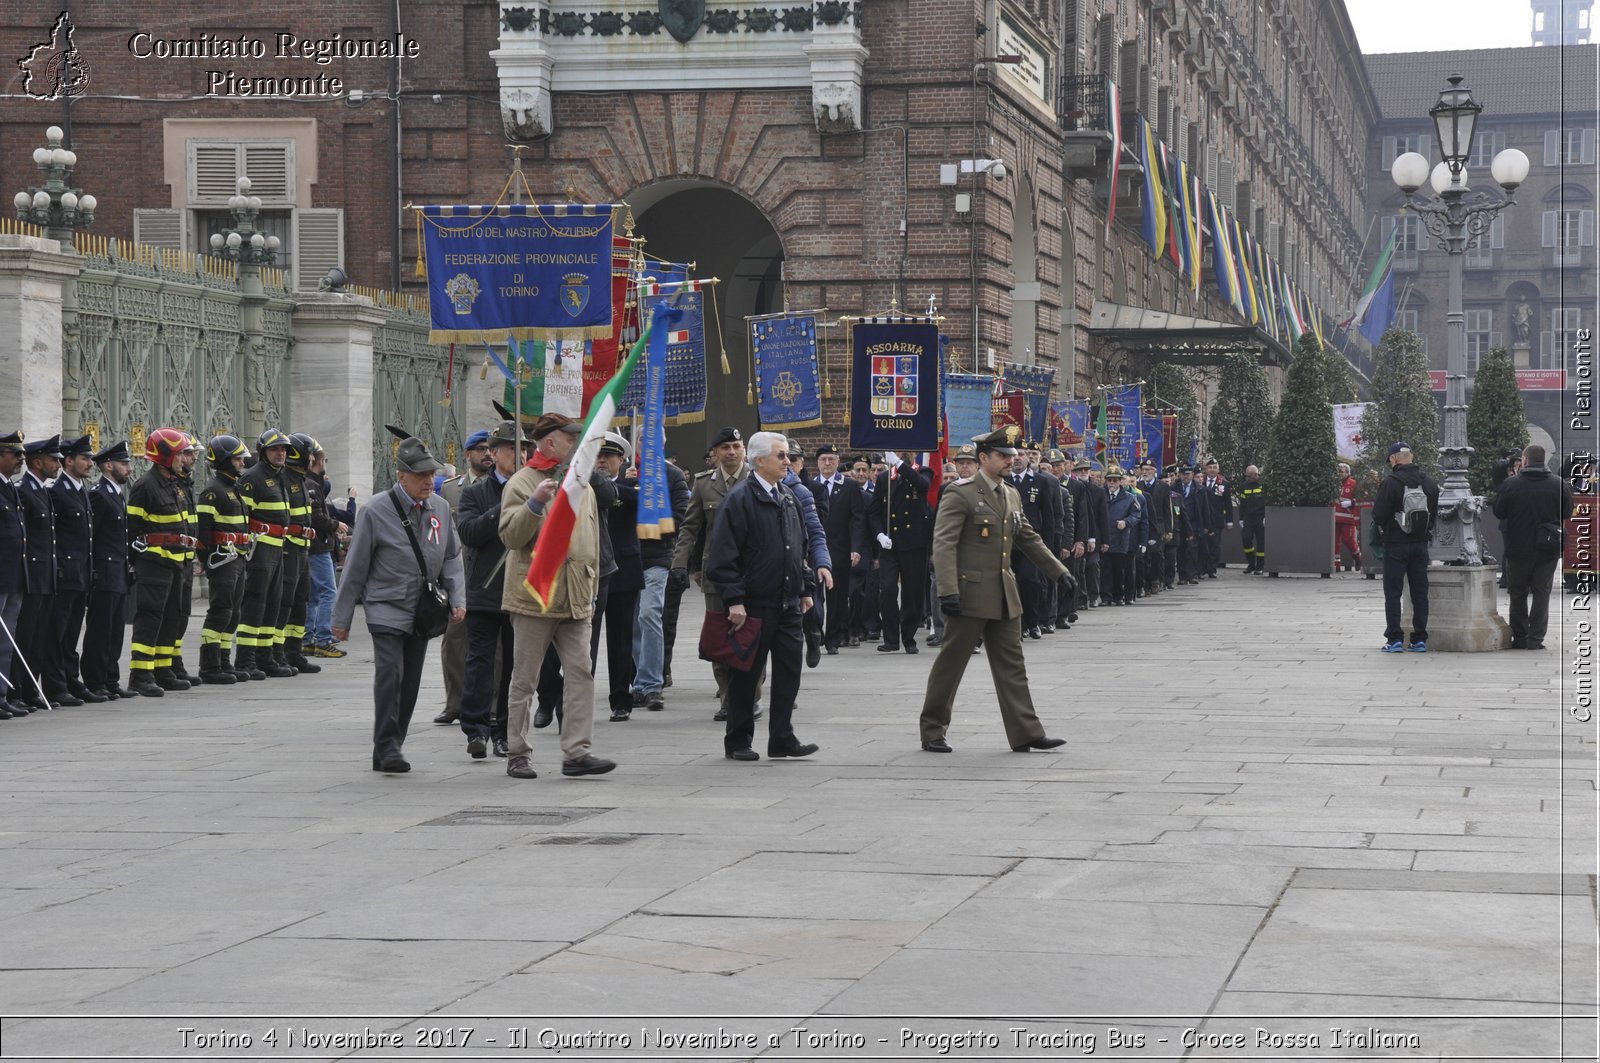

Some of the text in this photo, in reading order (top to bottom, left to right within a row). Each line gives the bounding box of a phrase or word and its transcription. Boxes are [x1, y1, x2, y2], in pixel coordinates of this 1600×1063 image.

[438, 227, 598, 238] ISTITUTO DEL NASTRO AZZURRO
[445, 253, 598, 265] FEDERAZIONE PROVINCIALE
[513, 273, 524, 284] DI
[499, 286, 539, 297] TORINO
[768, 349, 803, 359] ITALIANA
[866, 342, 923, 356] ASSOARMA
[568, 370, 608, 380] PROVINCIALE
[546, 384, 582, 396] TORINESE
[874, 419, 913, 429] TORINO
